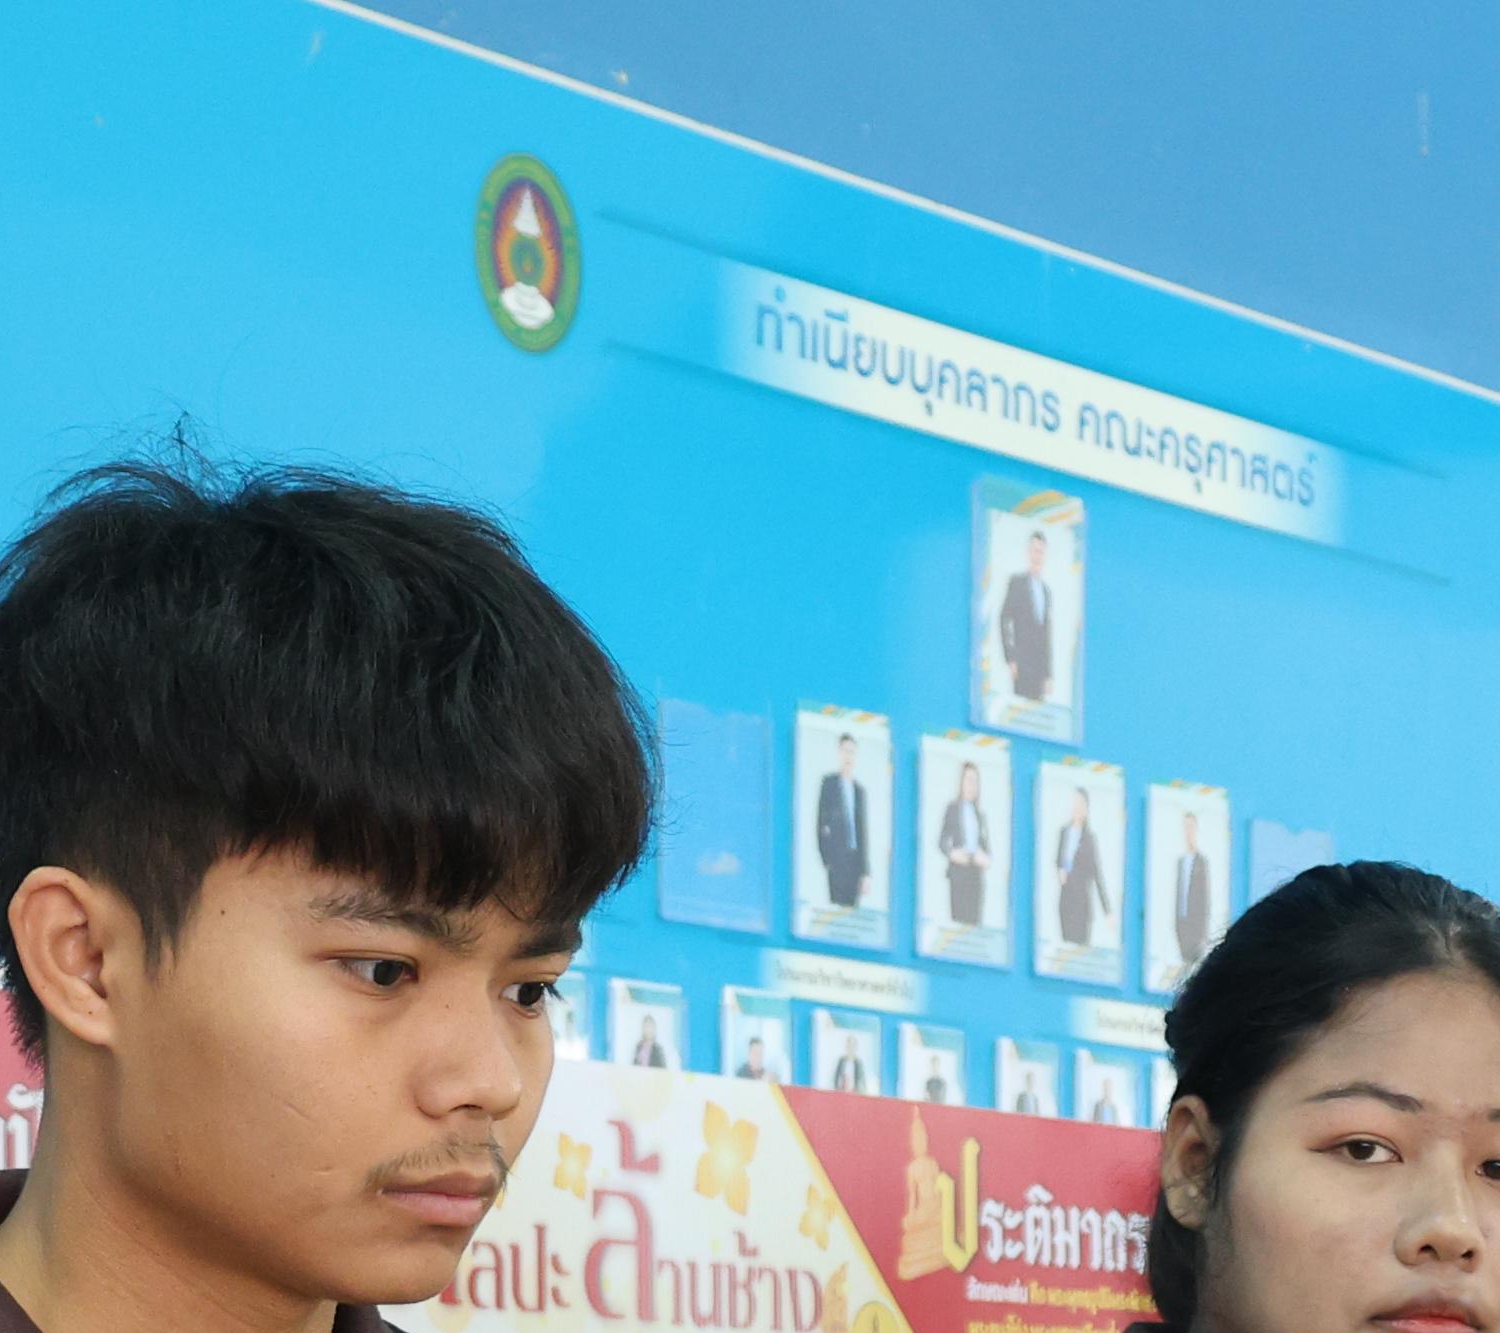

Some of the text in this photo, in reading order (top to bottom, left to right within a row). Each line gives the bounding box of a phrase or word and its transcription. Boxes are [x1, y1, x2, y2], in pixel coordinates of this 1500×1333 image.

[754, 287, 1320, 510] ทำเนียบบุคลากร คณะครุศาสตร์
